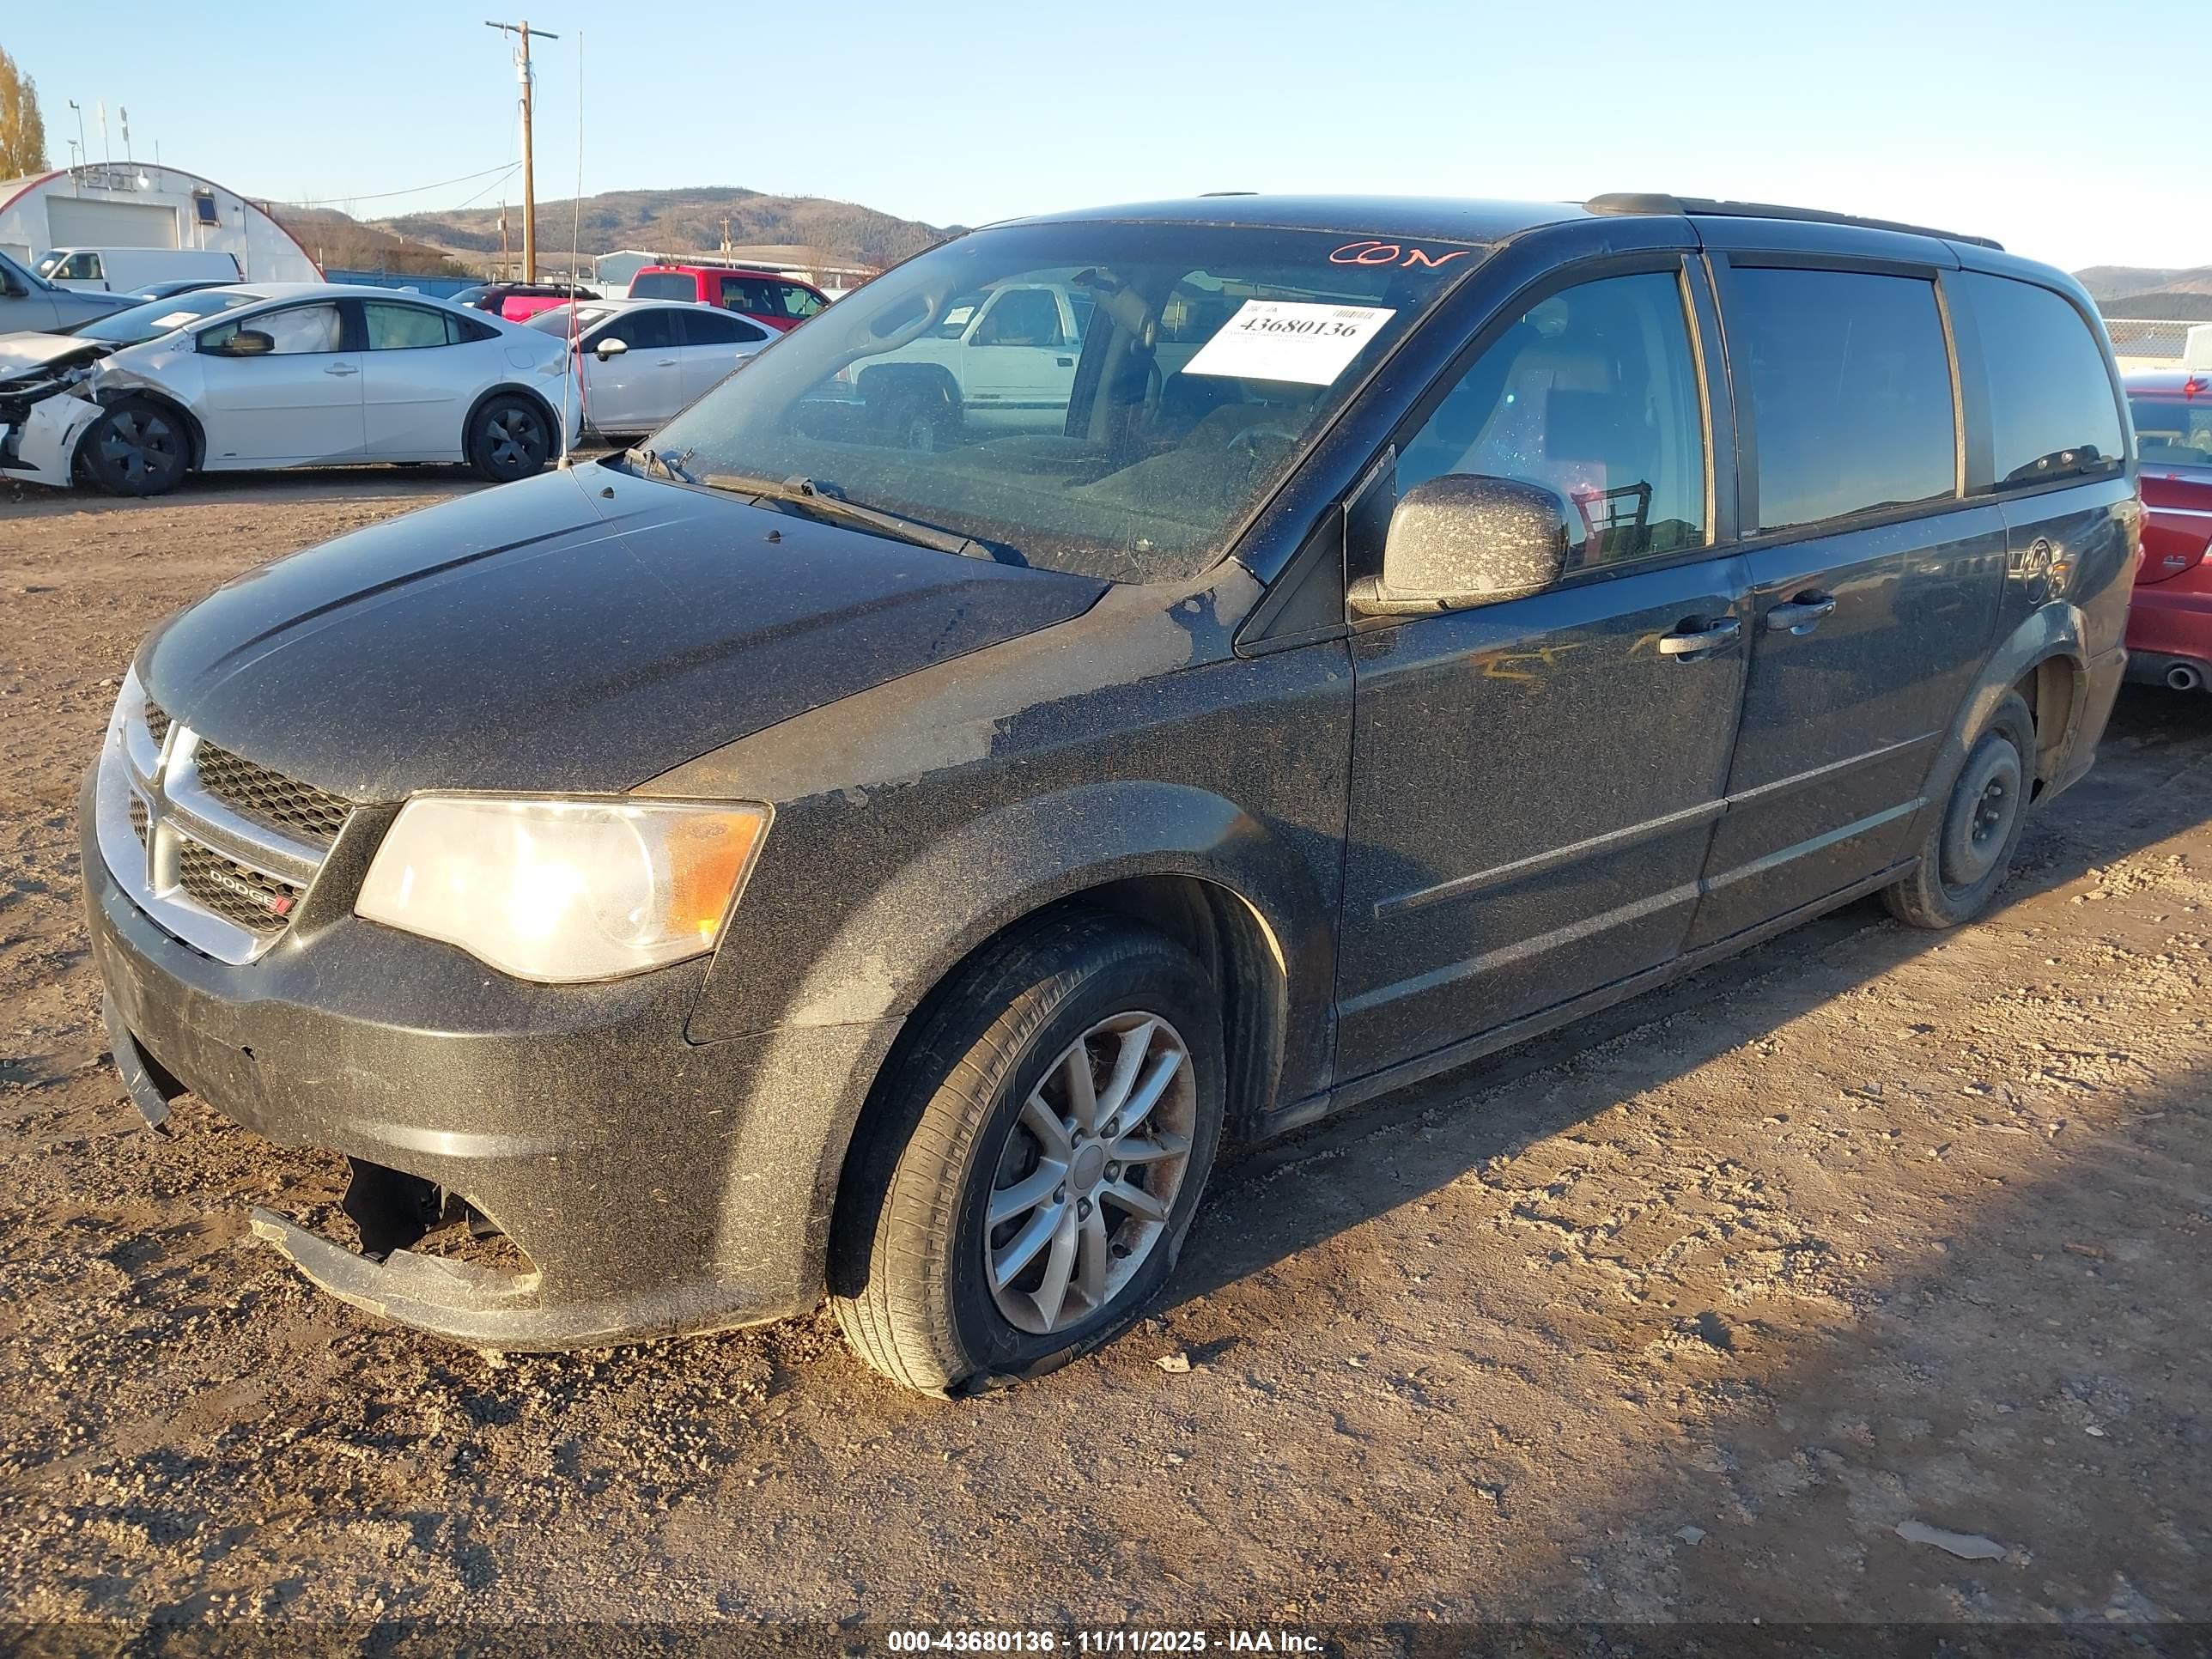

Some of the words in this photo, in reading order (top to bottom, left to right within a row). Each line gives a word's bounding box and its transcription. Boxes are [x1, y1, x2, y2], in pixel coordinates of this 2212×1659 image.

[1329, 240, 1471, 268] CON
[1239, 317, 1361, 337] 43680136
[210, 869, 277, 908] DODGE
